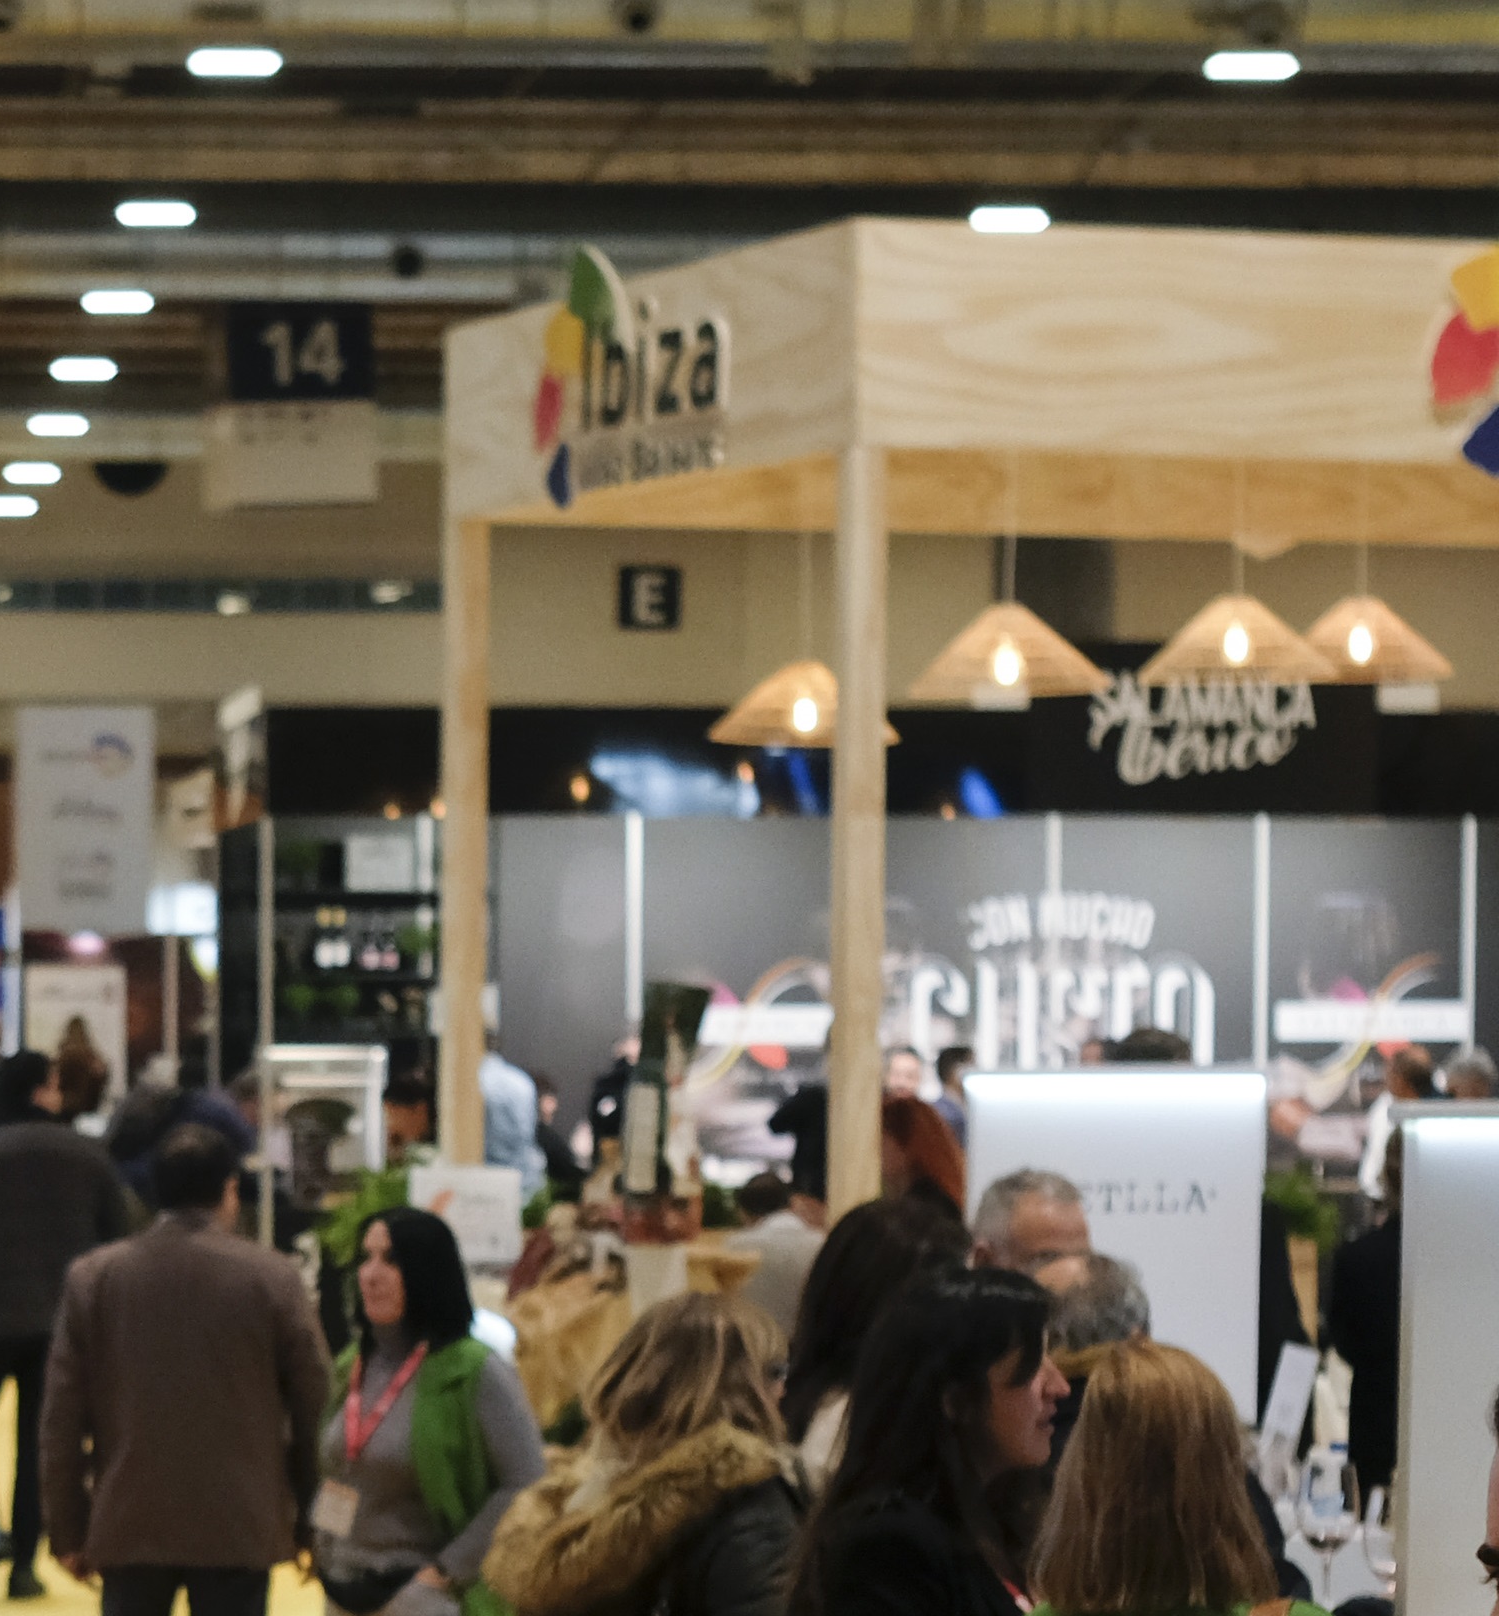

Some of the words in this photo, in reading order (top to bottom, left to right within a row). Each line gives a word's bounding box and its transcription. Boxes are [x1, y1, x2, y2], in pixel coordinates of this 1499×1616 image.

[261, 321, 345, 387] 14
[580, 298, 718, 432] Ibiza
[632, 572, 667, 625] E
